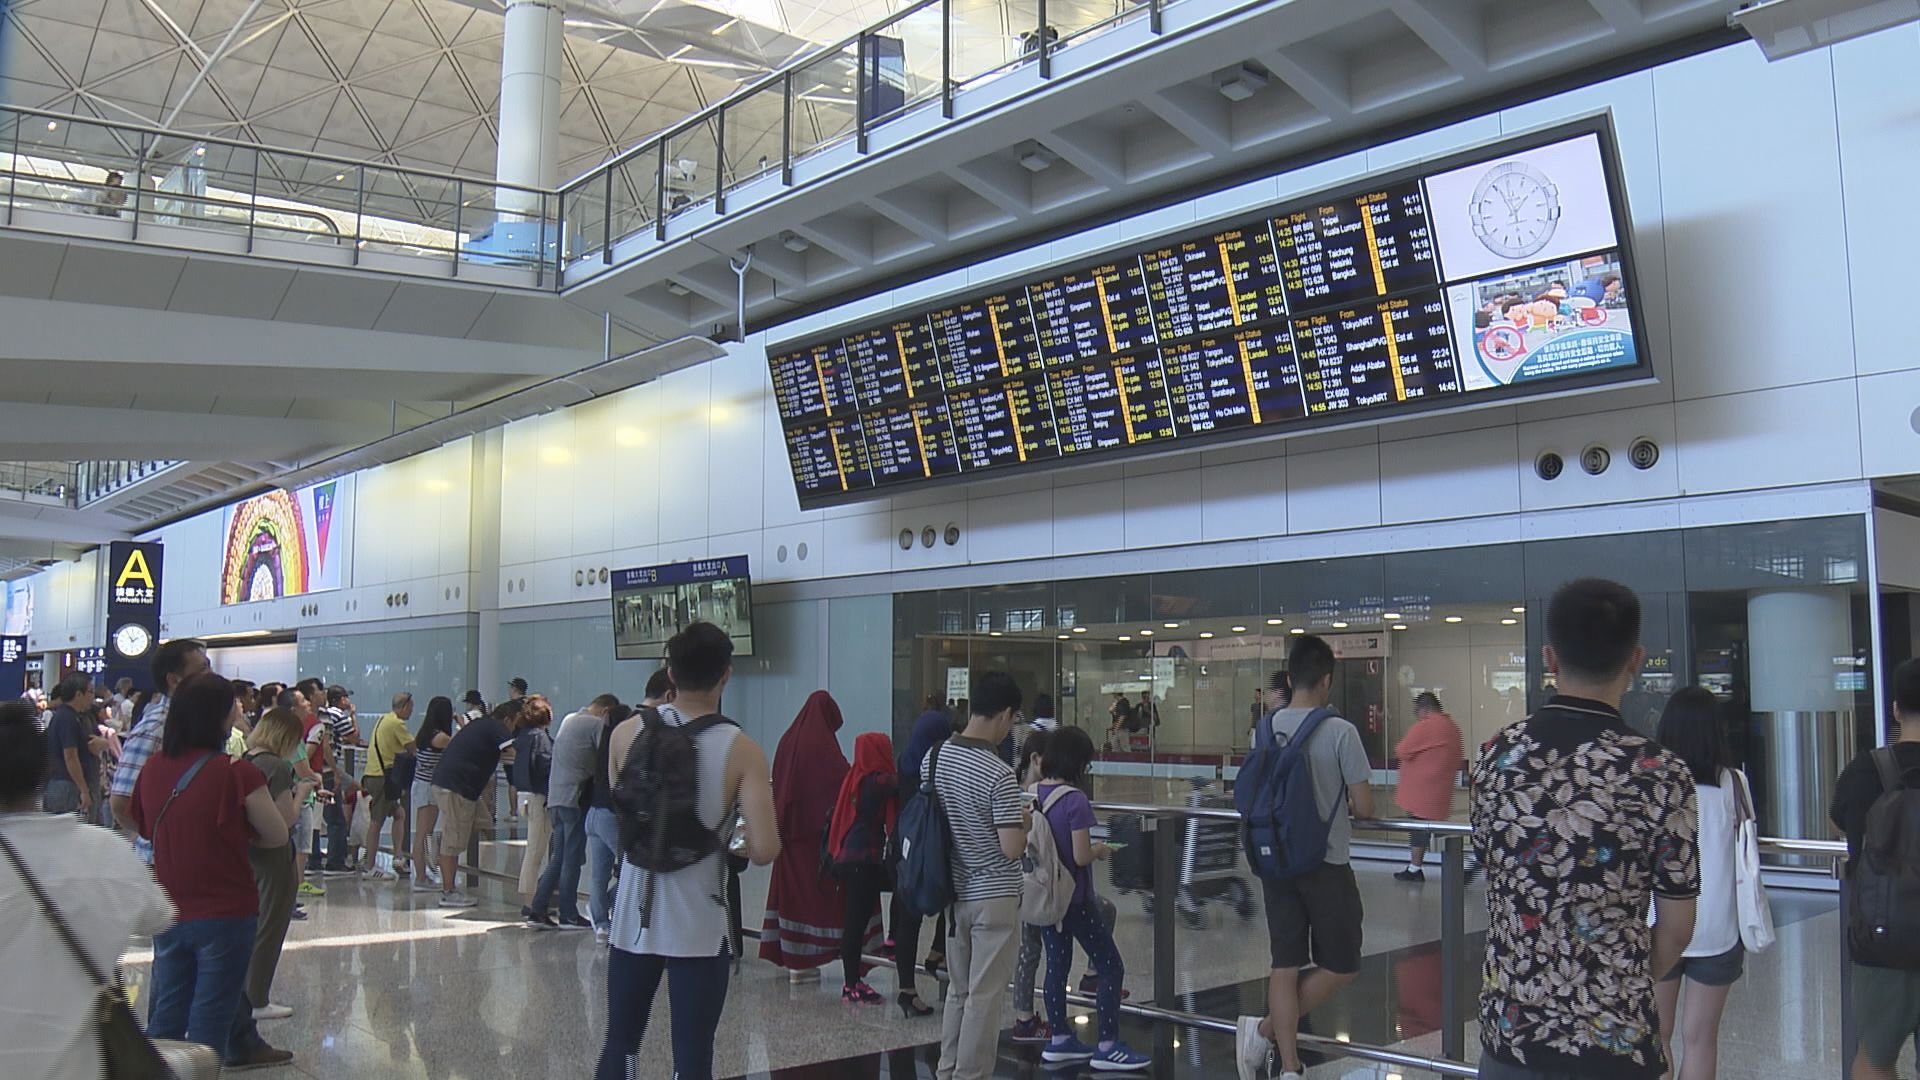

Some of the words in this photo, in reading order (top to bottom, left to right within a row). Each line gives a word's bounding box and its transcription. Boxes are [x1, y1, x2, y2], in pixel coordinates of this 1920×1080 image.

[1291, 212, 1307, 222] Flight
[1319, 206, 1334, 215] From
[1356, 197, 1368, 206] Hall
[1369, 192, 1387, 201] Status
[1321, 214, 1339, 227] Taipei
[1370, 203, 1381, 213] Est
[1402, 193, 1419, 205] 14:11
[1323, 226, 1339, 236] Kuala
[1339, 220, 1362, 234] Lumpur
[1372, 215, 1383, 224] Est
[1283, 259, 1298, 268] 14:30
[1299, 256, 1308, 264] AE
[1327, 245, 1354, 259] Taichung
[1376, 237, 1387, 246] Est
[1409, 227, 1426, 238] 14:40
[1285, 269, 1300, 279] 14:30
[1301, 266, 1310, 275] AY
[1329, 257, 1352, 269] Helsinki
[1378, 248, 1389, 257] Est
[1287, 279, 1302, 290] 14:30
[1331, 267, 1357, 281] Bangkok
[1381, 259, 1392, 269] Est
[1413, 250, 1431, 261] 14:40
[1269, 305, 1284, 315] 14:14
[1294, 319, 1308, 327] Time
[1310, 315, 1327, 325] Flight
[1339, 309, 1355, 318] From
[1376, 302, 1389, 311] Hall
[1389, 298, 1408, 308] Status
[1391, 310, 1402, 320] Est
[1423, 302, 1441, 313] 14:00
[1395, 332, 1406, 342] Est
[1321, 369, 1330, 378] ET
[1349, 363, 1366, 373] Addis
[1366, 359, 1386, 370] Ababa
[1399, 354, 1410, 364] Est
[1431, 347, 1450, 358] 22:24
[1351, 374, 1365, 384] Nadi
[1401, 365, 1412, 375] Est
[1434, 358, 1451, 369] 14:41
[1405, 387, 1417, 397] Est
[1438, 380, 1456, 392] 14:45
[116, 549, 154, 588] A
[720, 561, 728, 575] A
